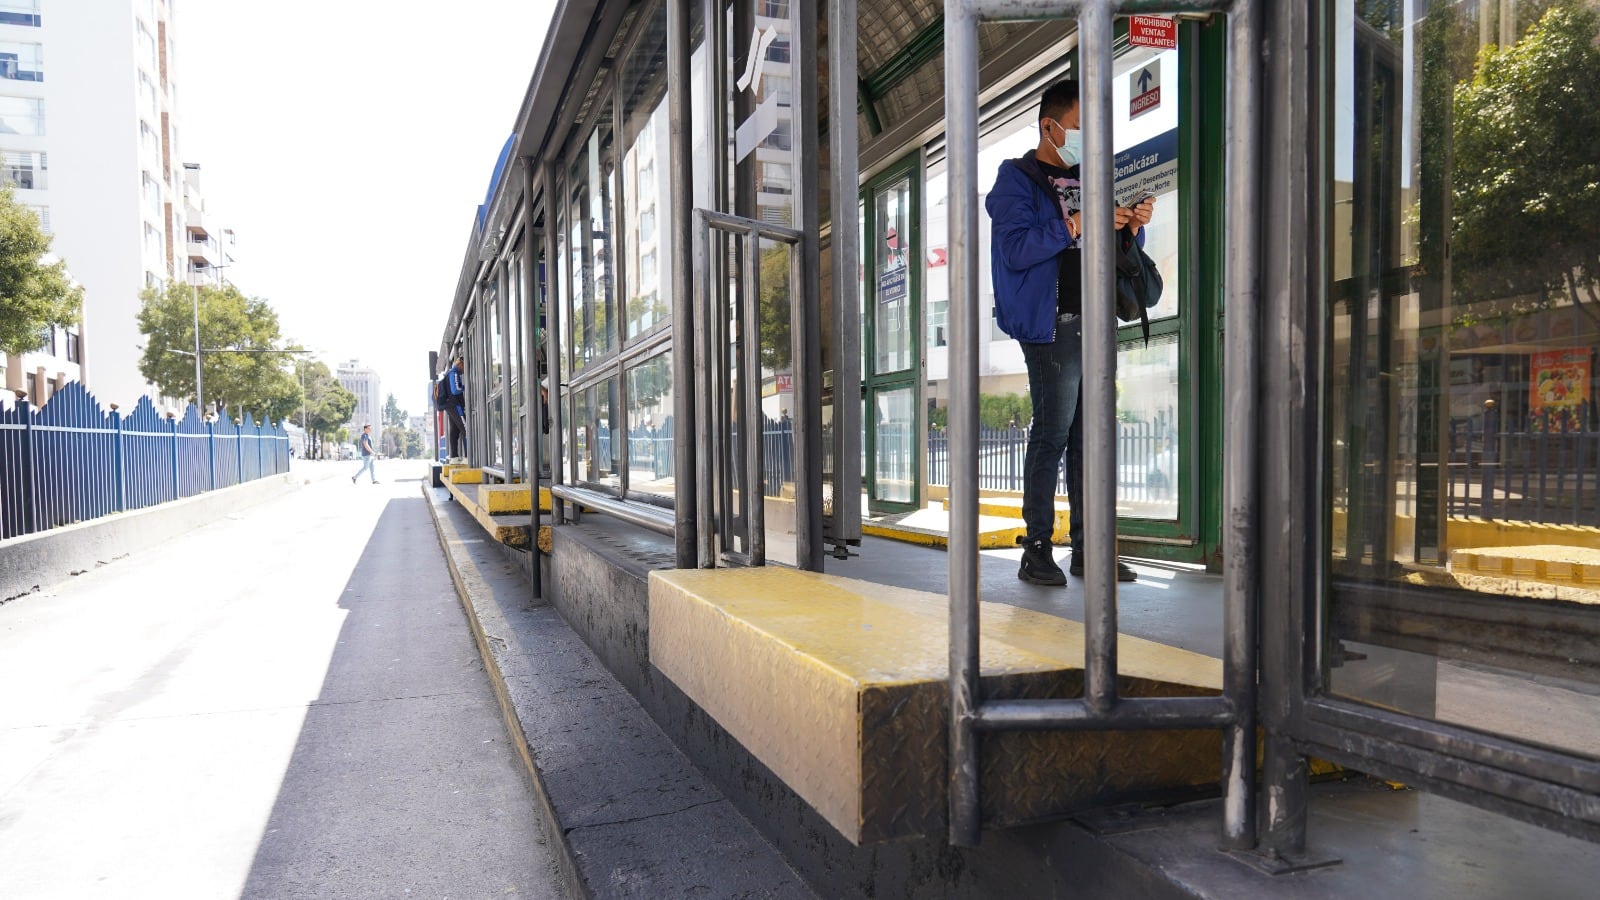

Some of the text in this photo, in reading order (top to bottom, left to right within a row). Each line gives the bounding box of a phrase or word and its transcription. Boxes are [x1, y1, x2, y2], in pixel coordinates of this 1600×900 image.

[1134, 17, 1172, 28] PROHIBIDO
[1140, 27, 1166, 37] VENTAS
[1131, 35, 1175, 47] AMBULANTES
[1130, 91, 1159, 113] INGRESO
[1113, 153, 1159, 179] Benalcázar
[1154, 180, 1171, 191] Norte
